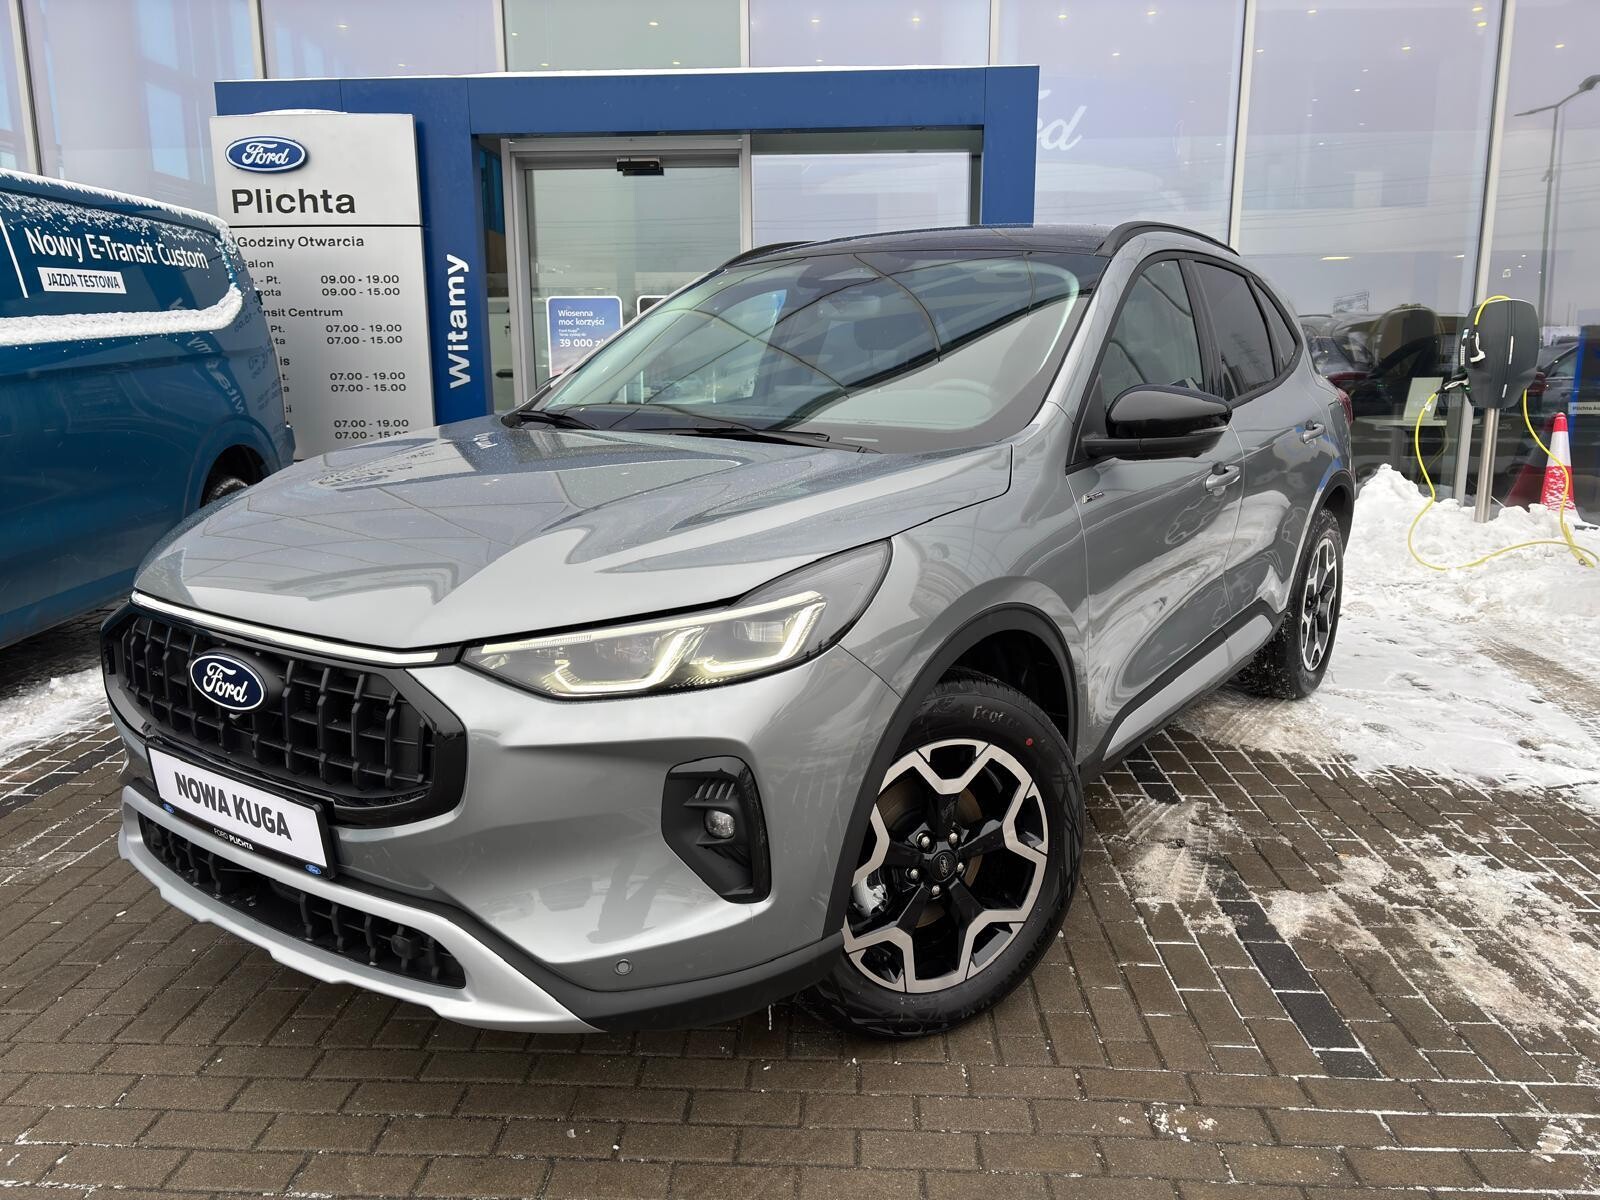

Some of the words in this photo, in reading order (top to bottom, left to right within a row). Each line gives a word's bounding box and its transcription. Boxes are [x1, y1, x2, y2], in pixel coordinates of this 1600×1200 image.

[241, 142, 289, 165] Ford
[231, 188, 356, 214] Plichta
[237, 236, 295, 249] Godziny
[297, 236, 365, 247] Otwarcia
[24, 227, 83, 263] Nowy
[85, 233, 157, 265] E-Transit
[157, 242, 210, 270] Custom
[244, 259, 274, 269] alon
[47, 272, 78, 288] JAZDA
[77, 273, 120, 289] TESTOWA
[266, 276, 281, 285] Pt.
[320, 275, 356, 285] 09.00
[367, 274, 400, 284] 19.00
[321, 288, 357, 297] 09.00
[367, 287, 401, 296] 15.00
[263, 307, 286, 317] nsit
[288, 308, 343, 317] Centrum
[557, 309, 593, 317] Wiosenna
[446, 253, 471, 389] Witamy
[575, 317, 605, 327] korzyści
[325, 324, 359, 334] 07.00
[369, 324, 402, 333] 19.00
[326, 336, 360, 345] 07.00
[370, 335, 403, 344] 15.00
[559, 338, 571, 348] 39
[573, 338, 593, 348] 000
[329, 372, 363, 381] 07.00
[372, 371, 406, 381] 19.00
[331, 384, 364, 392] 07.00
[373, 383, 407, 392] 15.00
[333, 419, 366, 428] 07.00
[376, 419, 409, 428] 19.00
[334, 431, 367, 440] 07.00
[202, 662, 249, 703] Ford
[174, 771, 232, 818] NOWA
[232, 793, 293, 841] KUGA
